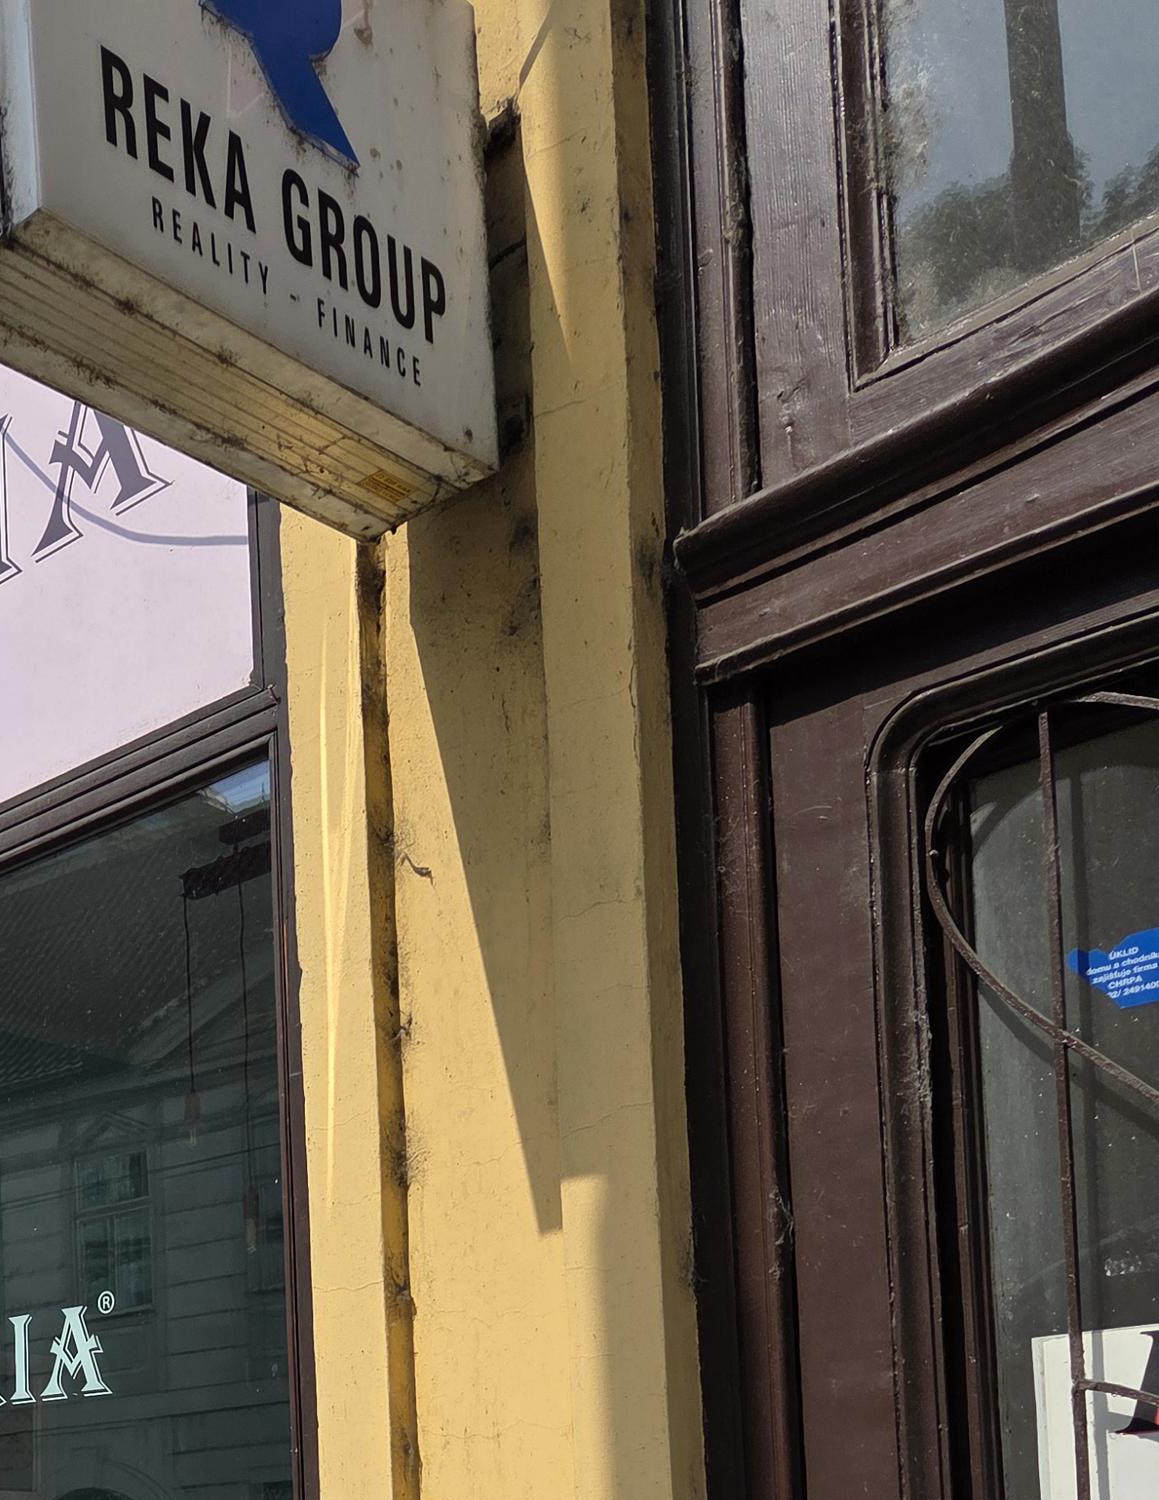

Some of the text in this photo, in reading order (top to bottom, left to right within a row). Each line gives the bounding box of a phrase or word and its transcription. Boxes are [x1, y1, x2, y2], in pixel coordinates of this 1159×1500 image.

[100, 45, 446, 345] REKA GROUP
[150, 195, 272, 296] REALITY
[317, 306, 423, 388] FINANCE
